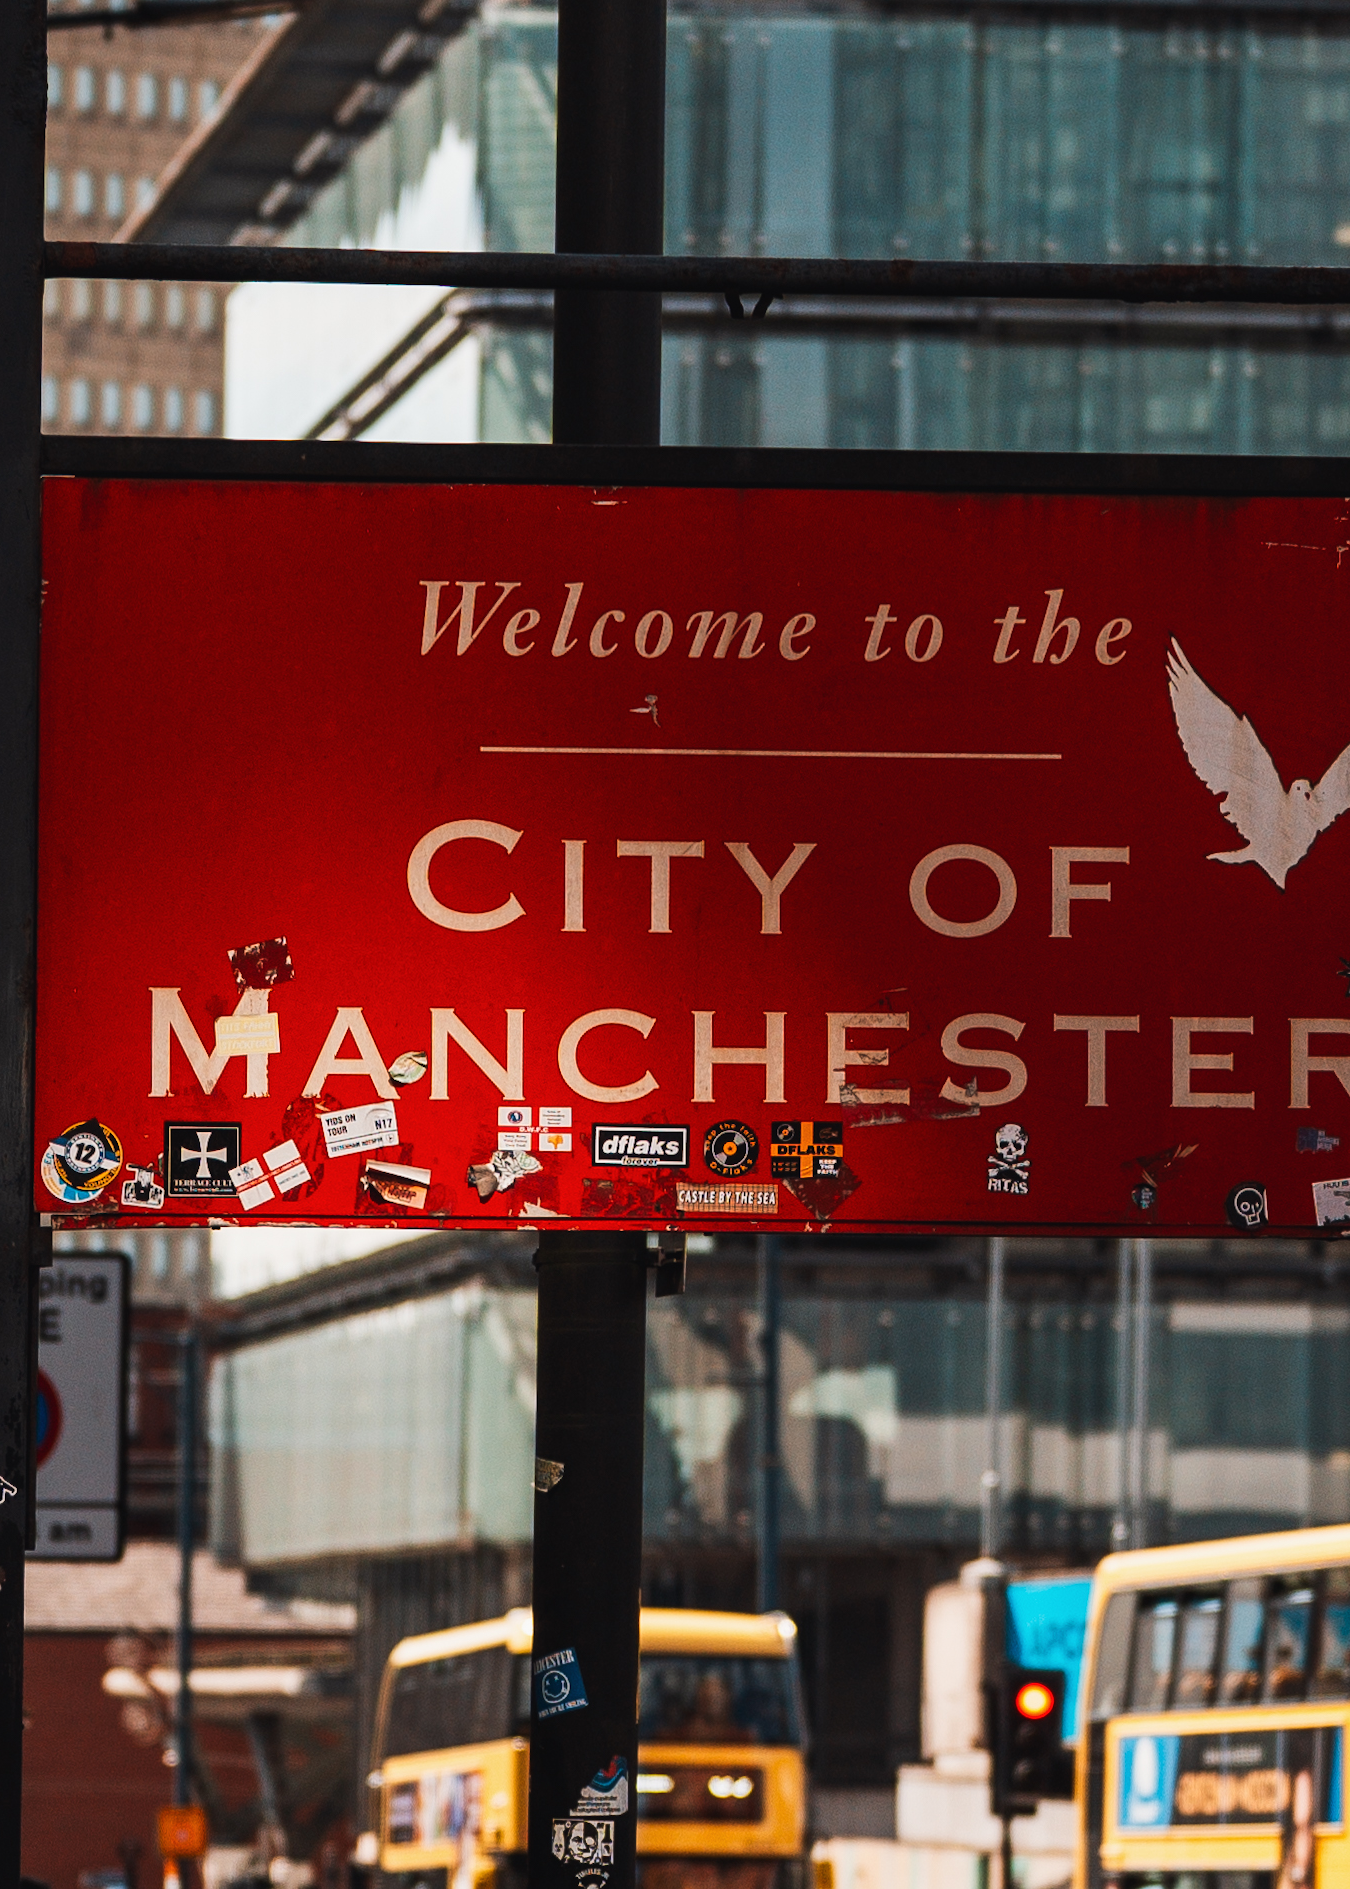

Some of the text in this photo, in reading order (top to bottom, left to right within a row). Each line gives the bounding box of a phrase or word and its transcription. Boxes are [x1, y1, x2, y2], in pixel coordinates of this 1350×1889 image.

[418, 580, 1134, 667] Welcome to the
[406, 819, 1131, 938] CITY OF
[325, 1113, 356, 1127] YIDS ON
[374, 1118, 393, 1130] N17
[327, 1125, 348, 1137] TOUR
[75, 1142, 97, 1165] 12
[602, 1135, 681, 1156] dflaks
[777, 1144, 836, 1156] DFLAKS
[987, 1177, 1029, 1195] RITAS
[678, 1189, 777, 1206] CASTLE BY THE SEA
[533, 1649, 575, 1676] ICESTER
